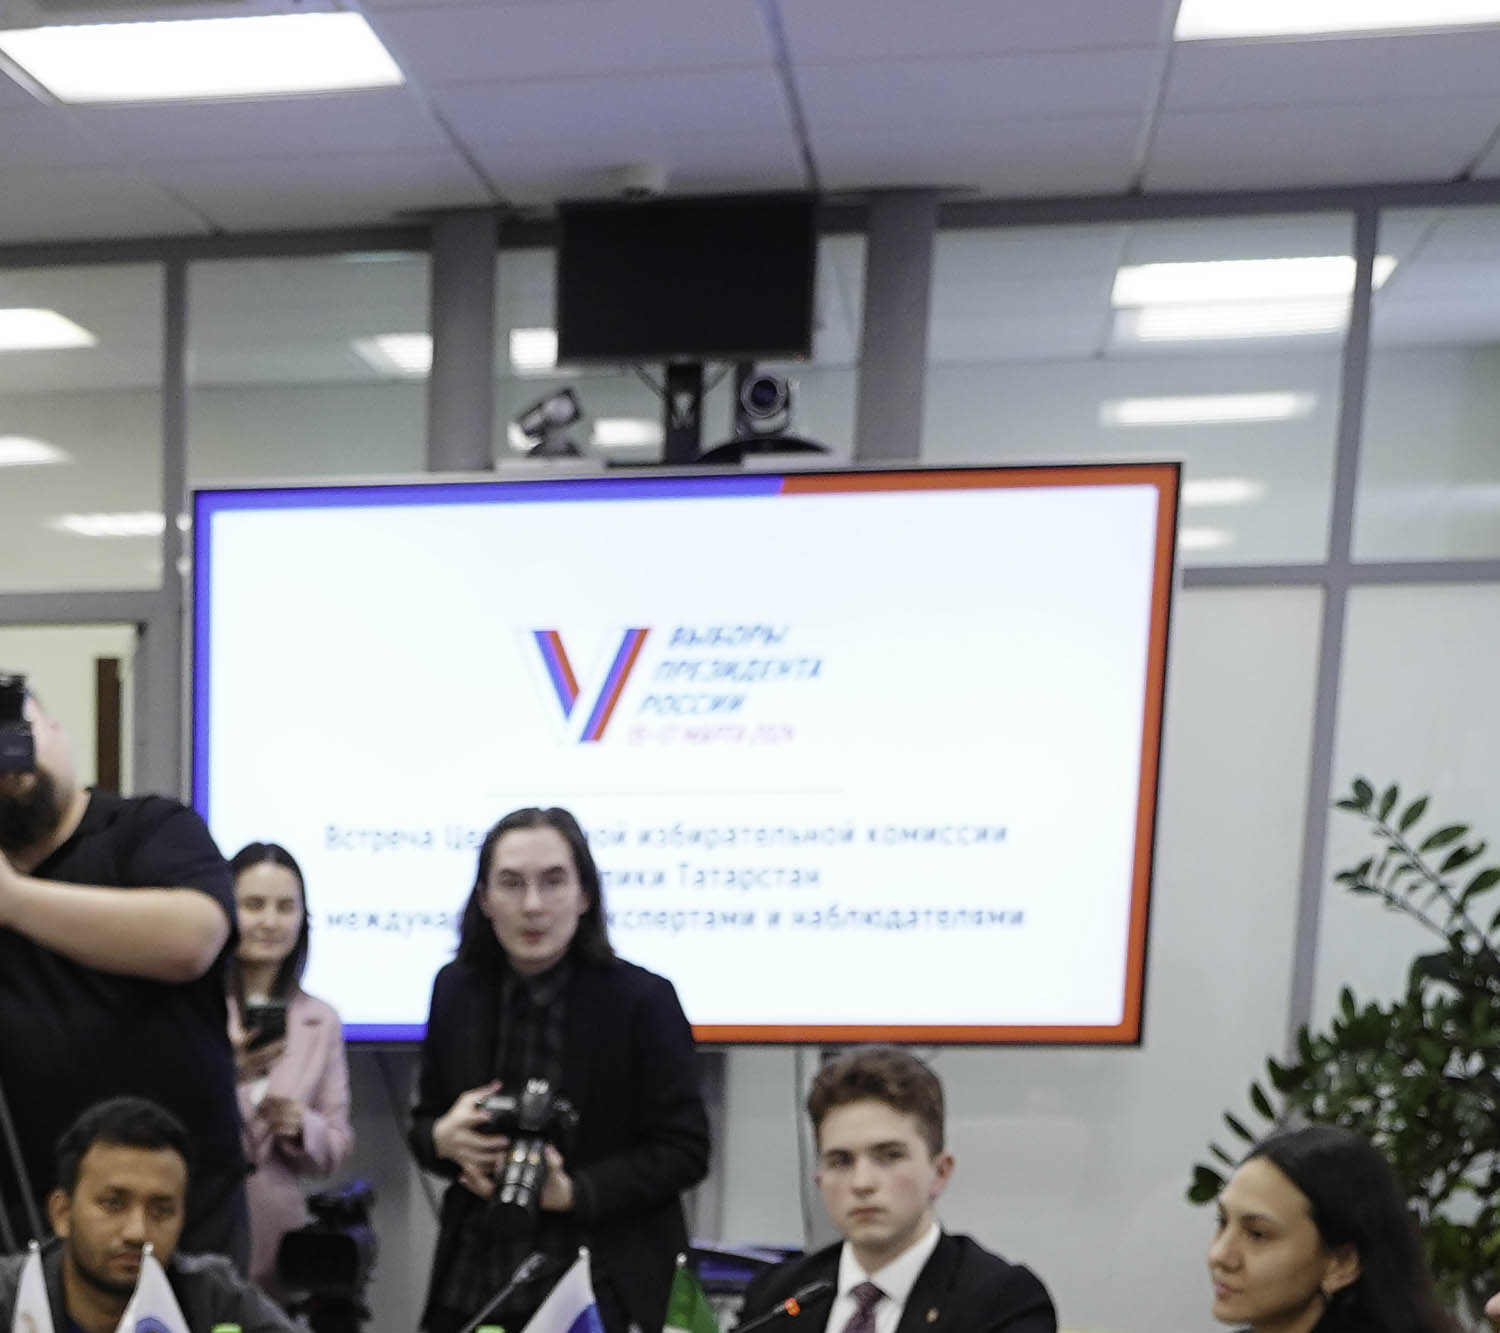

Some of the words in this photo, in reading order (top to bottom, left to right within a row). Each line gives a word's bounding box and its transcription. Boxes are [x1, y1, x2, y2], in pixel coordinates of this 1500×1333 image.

[668, 623, 790, 648] ВЫБОРЫ
[653, 656, 824, 682] ПРЕЗИДЕНТА
[638, 821, 854, 849] избирательной
[867, 823, 1008, 845] комиссии
[678, 863, 821, 890] Татарстан
[793, 904, 1026, 932] наблюдателями
